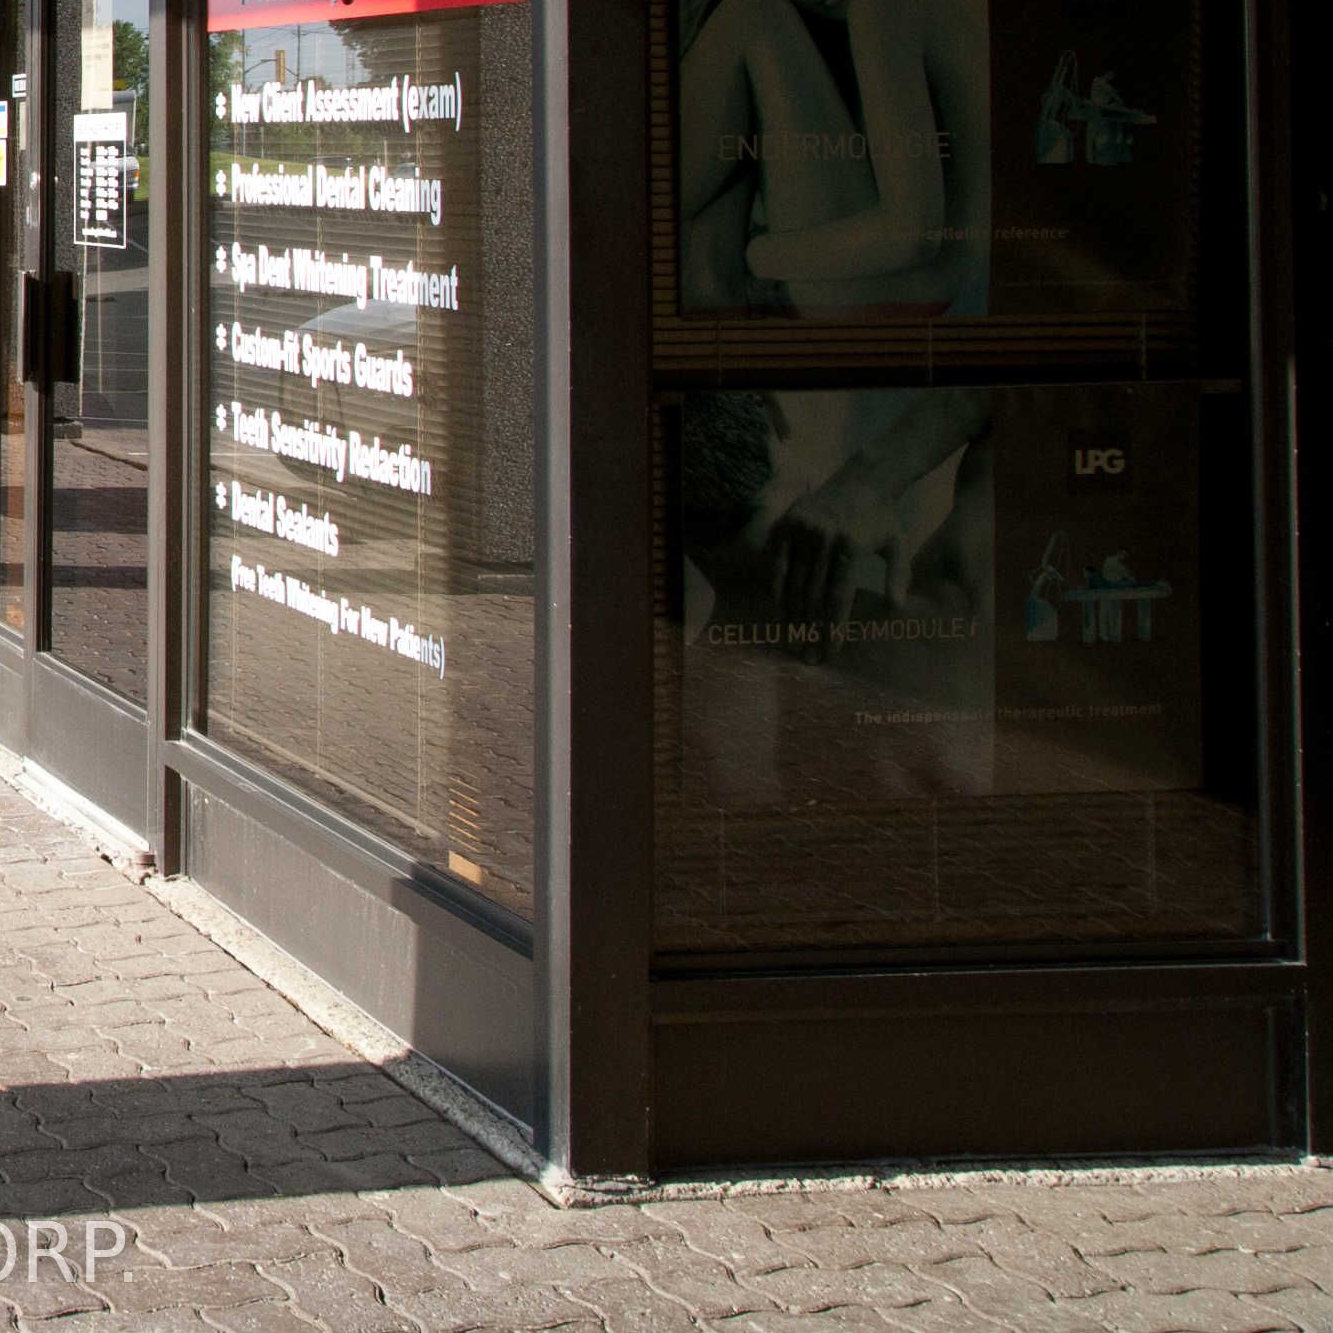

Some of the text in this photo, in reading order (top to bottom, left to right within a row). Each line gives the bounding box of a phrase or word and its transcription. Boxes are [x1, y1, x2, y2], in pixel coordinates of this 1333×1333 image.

[231, 71, 462, 133] New Client Assessment (exam)
[231, 163, 442, 225] Professional Dental Cleaning
[231, 242, 459, 311] Spa Dent Whitening Treatment
[231, 322, 413, 397] Custom-fit Sports Guards
[231, 401, 269, 449] Teeth
[271, 410, 347, 482] Sensitivity
[1074, 448, 1126, 475] LPG
[231, 480, 339, 557] Dental Sealants
[257, 564, 286, 604] Teeth
[361, 605, 388, 647] New
[389, 617, 445, 681] Patients)
[708, 623, 781, 646] CELLU
[787, 621, 821, 644] M6
[829, 617, 965, 643] KEYMODULE
[854, 710, 882, 725] The
[1088, 702, 1162, 718] treatment
